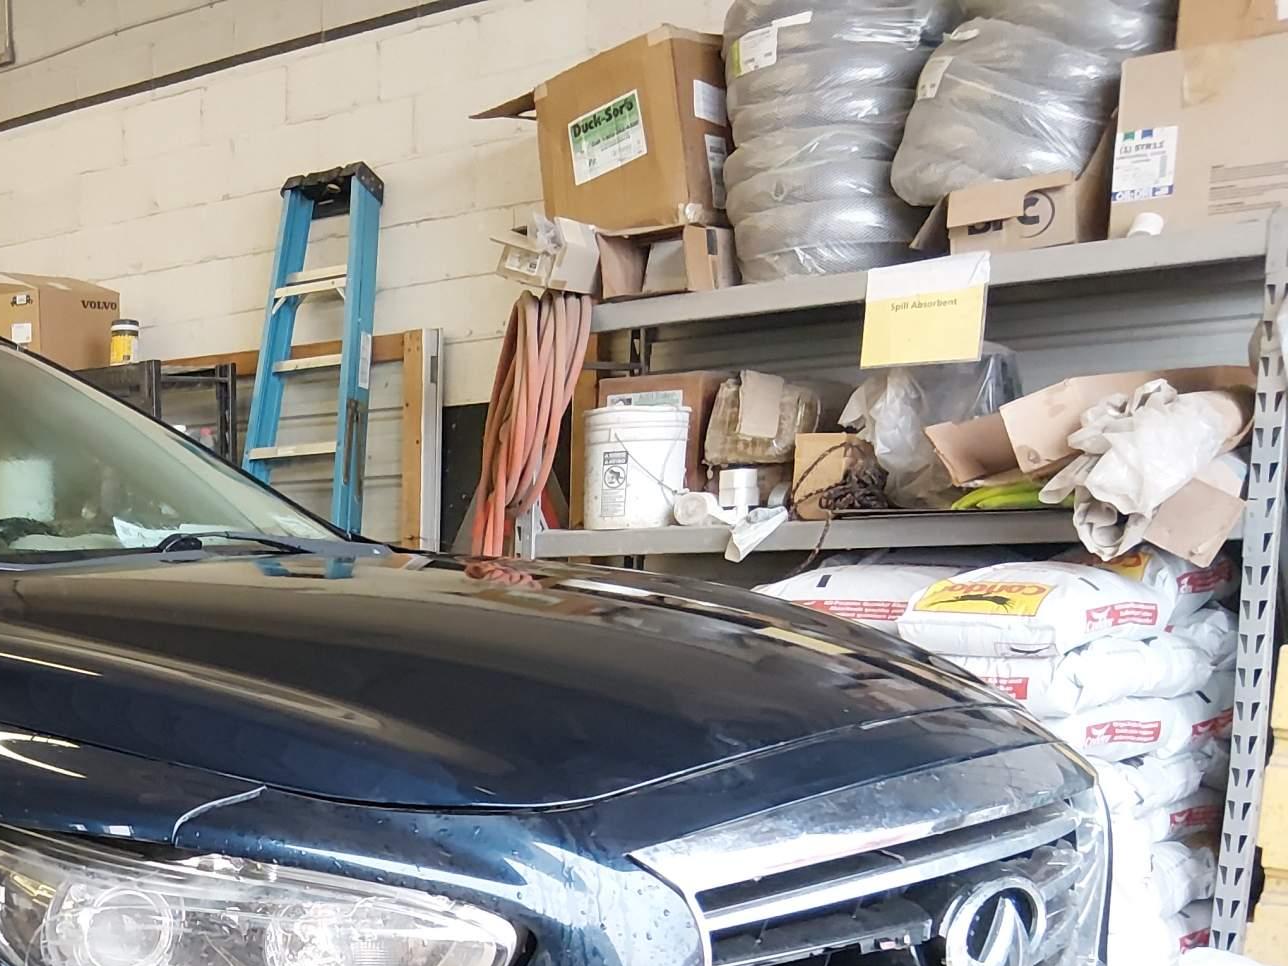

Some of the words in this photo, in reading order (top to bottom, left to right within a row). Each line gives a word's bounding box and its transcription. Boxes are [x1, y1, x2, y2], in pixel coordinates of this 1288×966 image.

[81, 300, 117, 310] VOLVO
[890, 301, 909, 312] Spill
[911, 298, 957, 309] Absorbent
